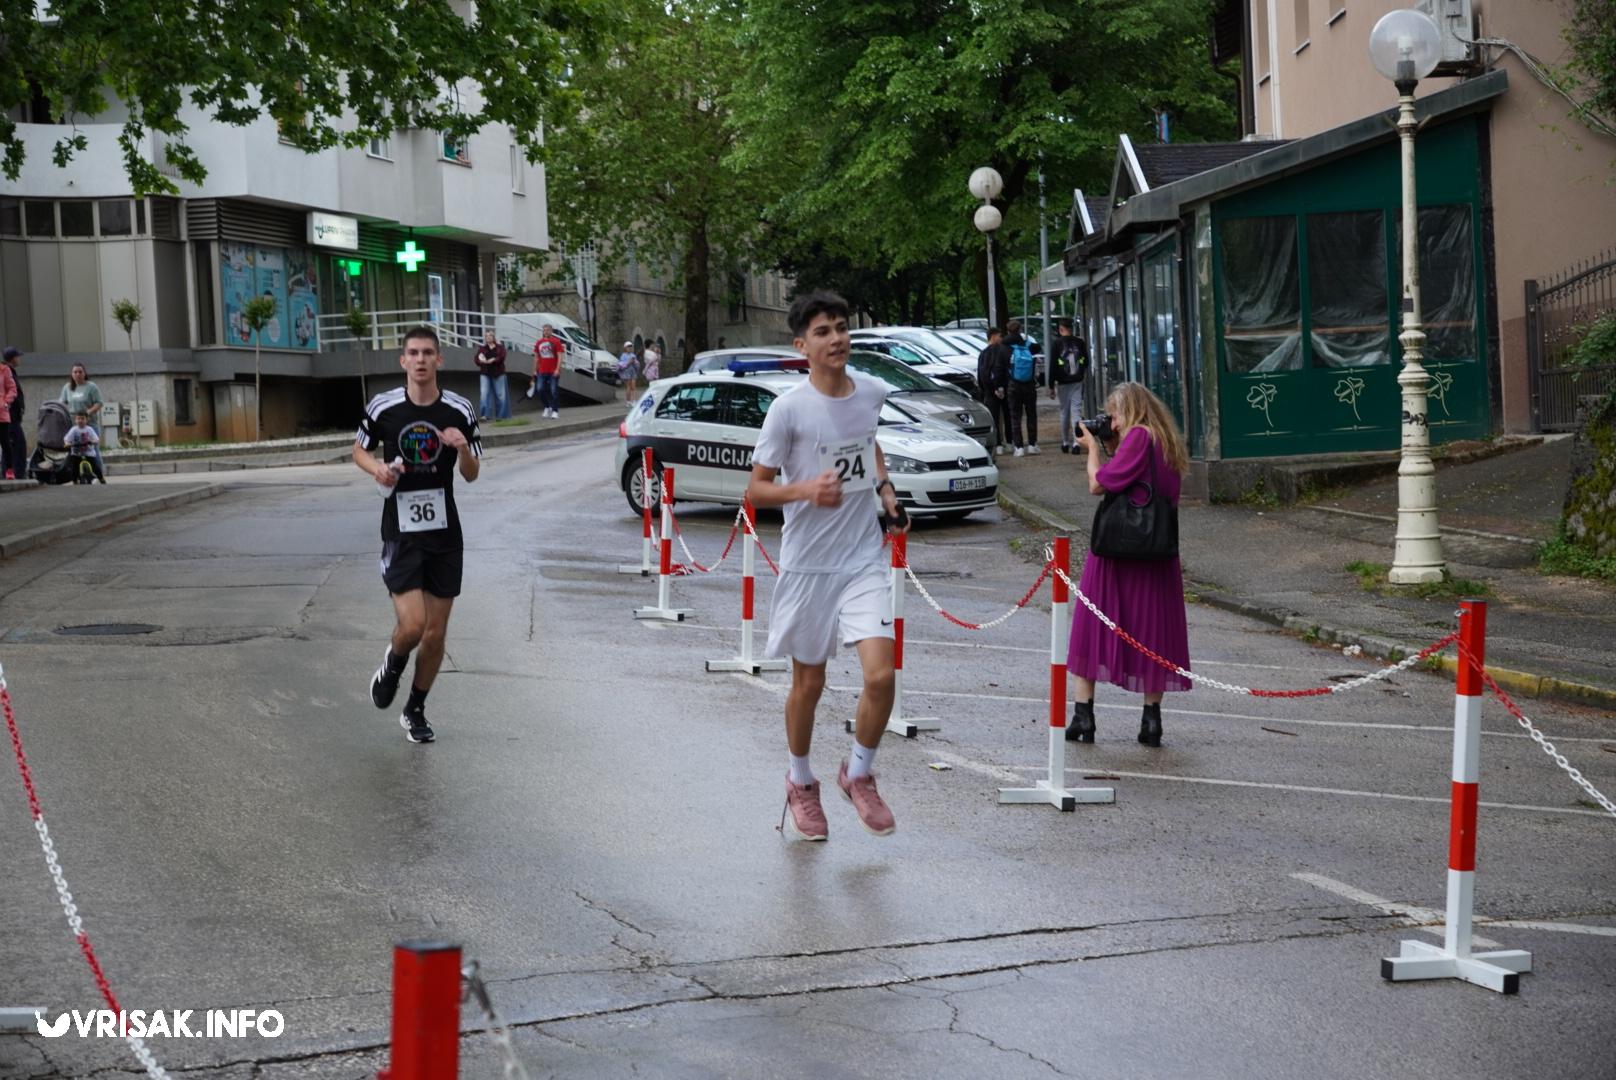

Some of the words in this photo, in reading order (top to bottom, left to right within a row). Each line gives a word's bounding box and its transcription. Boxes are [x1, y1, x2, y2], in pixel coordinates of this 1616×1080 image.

[687, 444, 753, 467] POLICIJA
[835, 454, 866, 482] 24
[410, 502, 436, 523] 36
